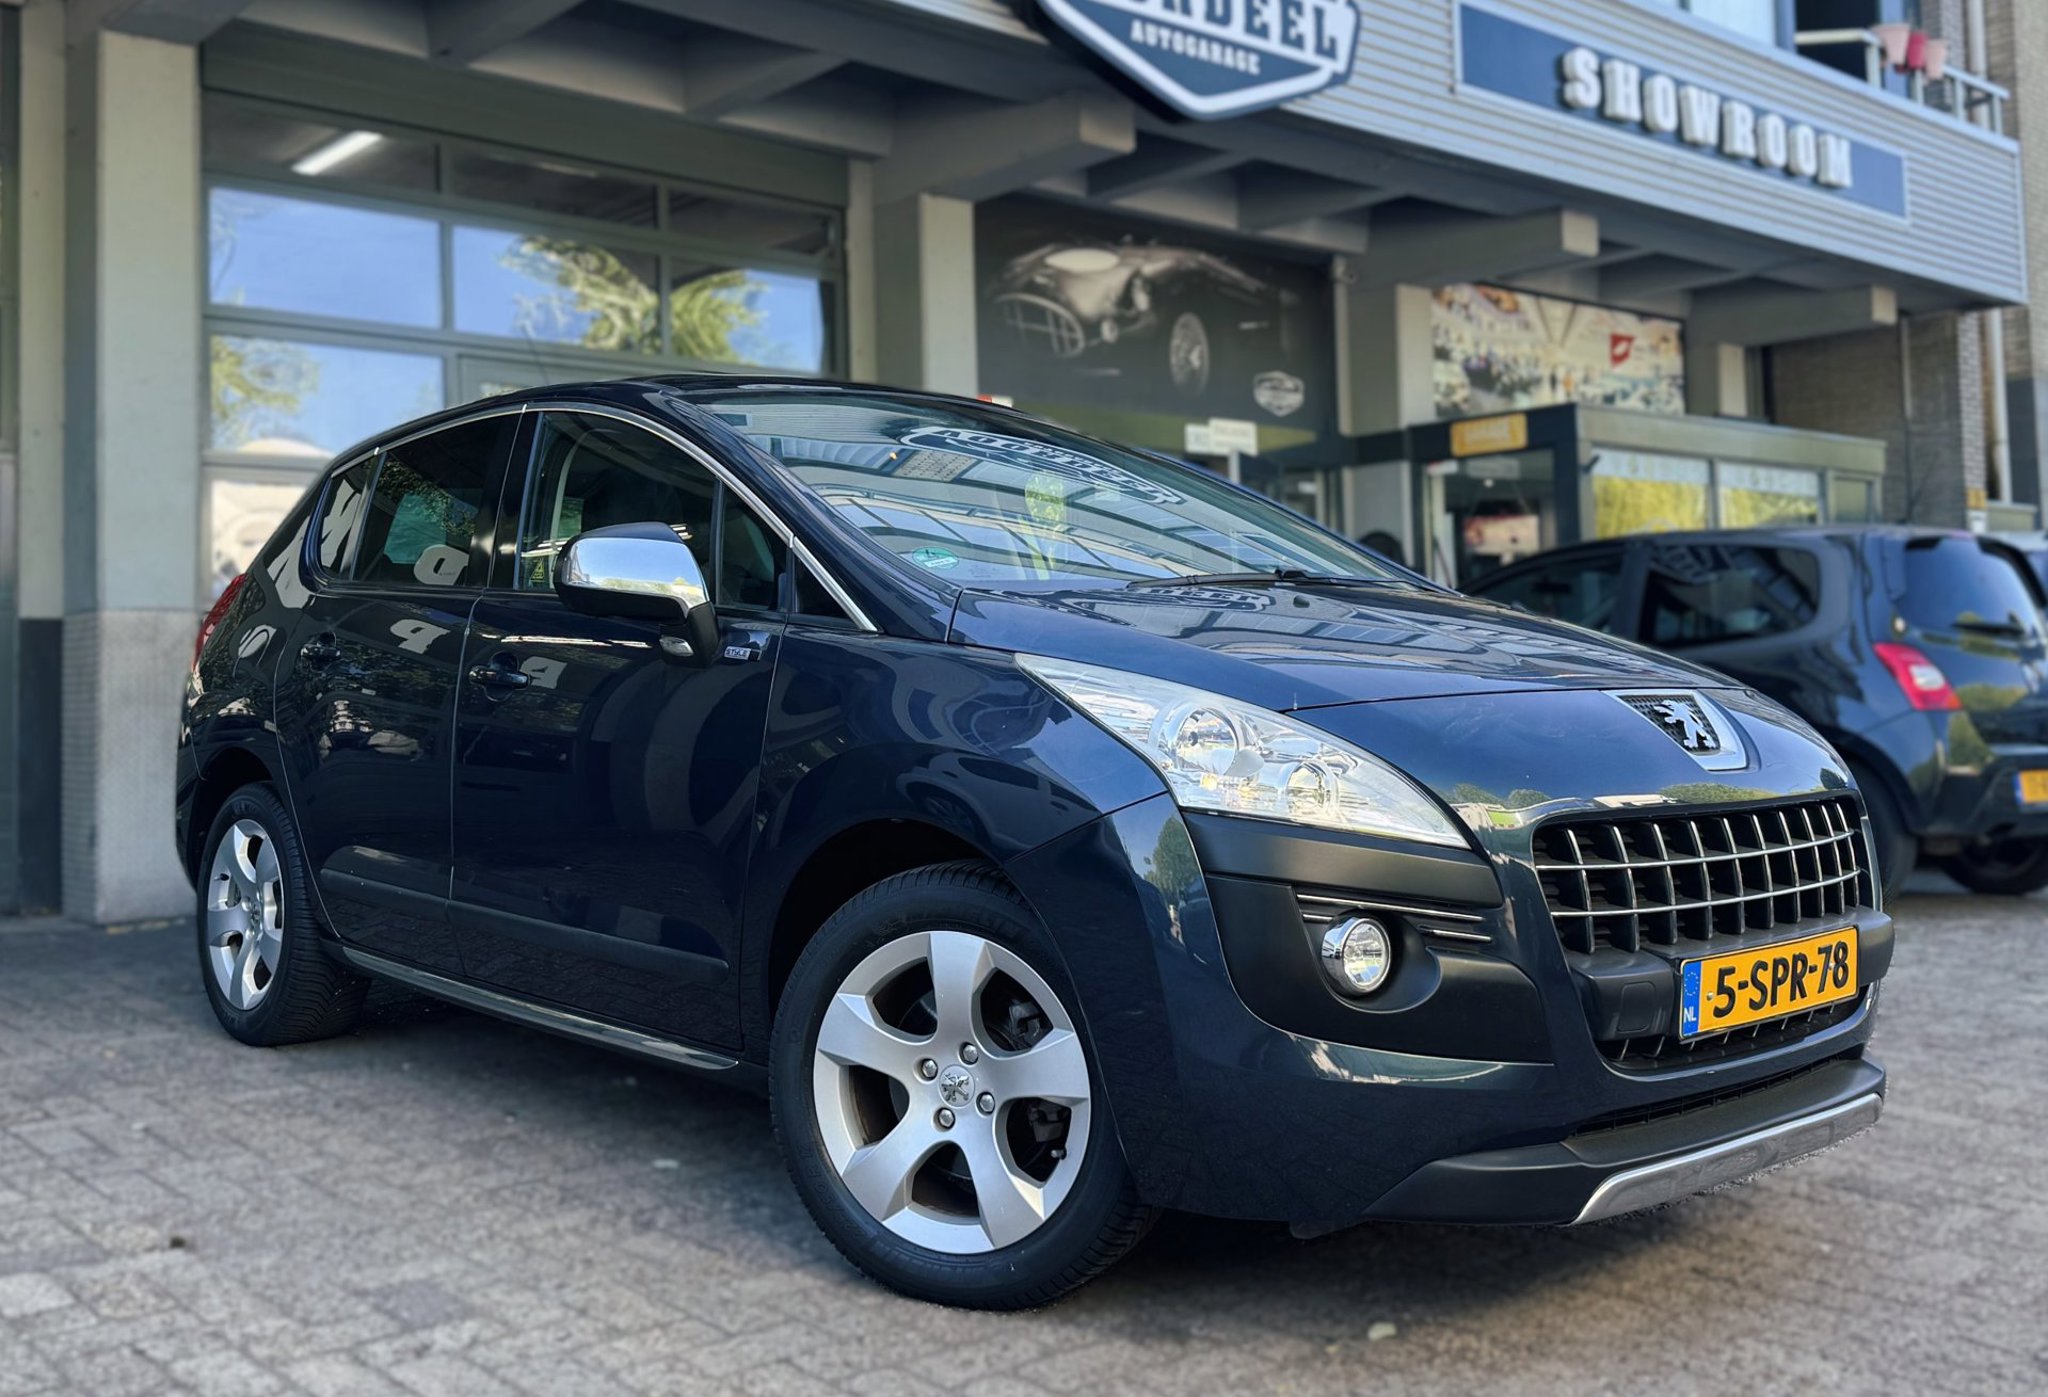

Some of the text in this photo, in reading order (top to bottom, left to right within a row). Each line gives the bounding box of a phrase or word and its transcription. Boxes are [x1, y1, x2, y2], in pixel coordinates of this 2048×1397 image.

[1130, 19, 1260, 75] AUTOGARAGE
[1562, 47, 1852, 188] SHOWROOM
[1713, 940, 1849, 1019] 5-SPR-78
[1683, 1007, 1697, 1023] NL
